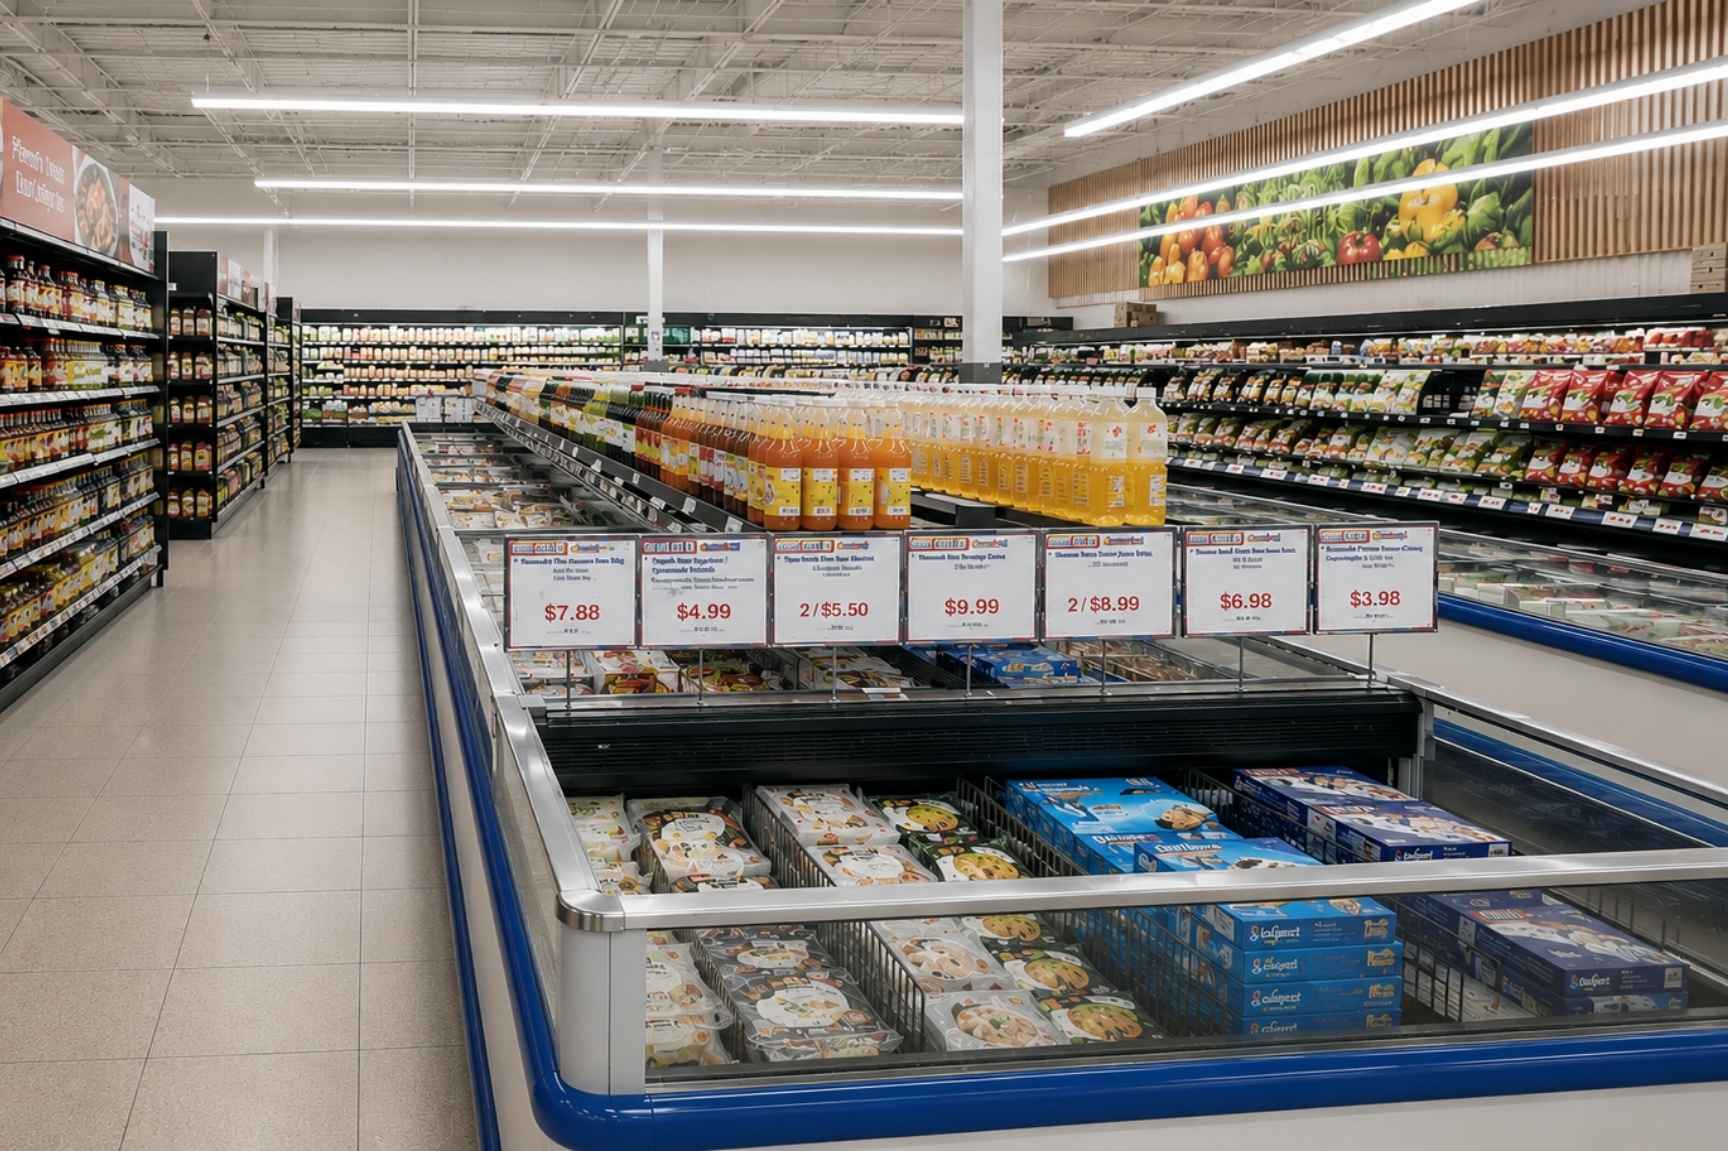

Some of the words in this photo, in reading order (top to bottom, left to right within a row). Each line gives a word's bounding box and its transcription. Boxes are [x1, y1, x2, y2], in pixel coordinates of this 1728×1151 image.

[944, 597, 1000, 617] $9.99
[1220, 591, 1273, 612] $6.98
[1350, 589, 1401, 609] $3.98
[544, 603, 600, 623] $7.88
[676, 602, 732, 622] $4.99
